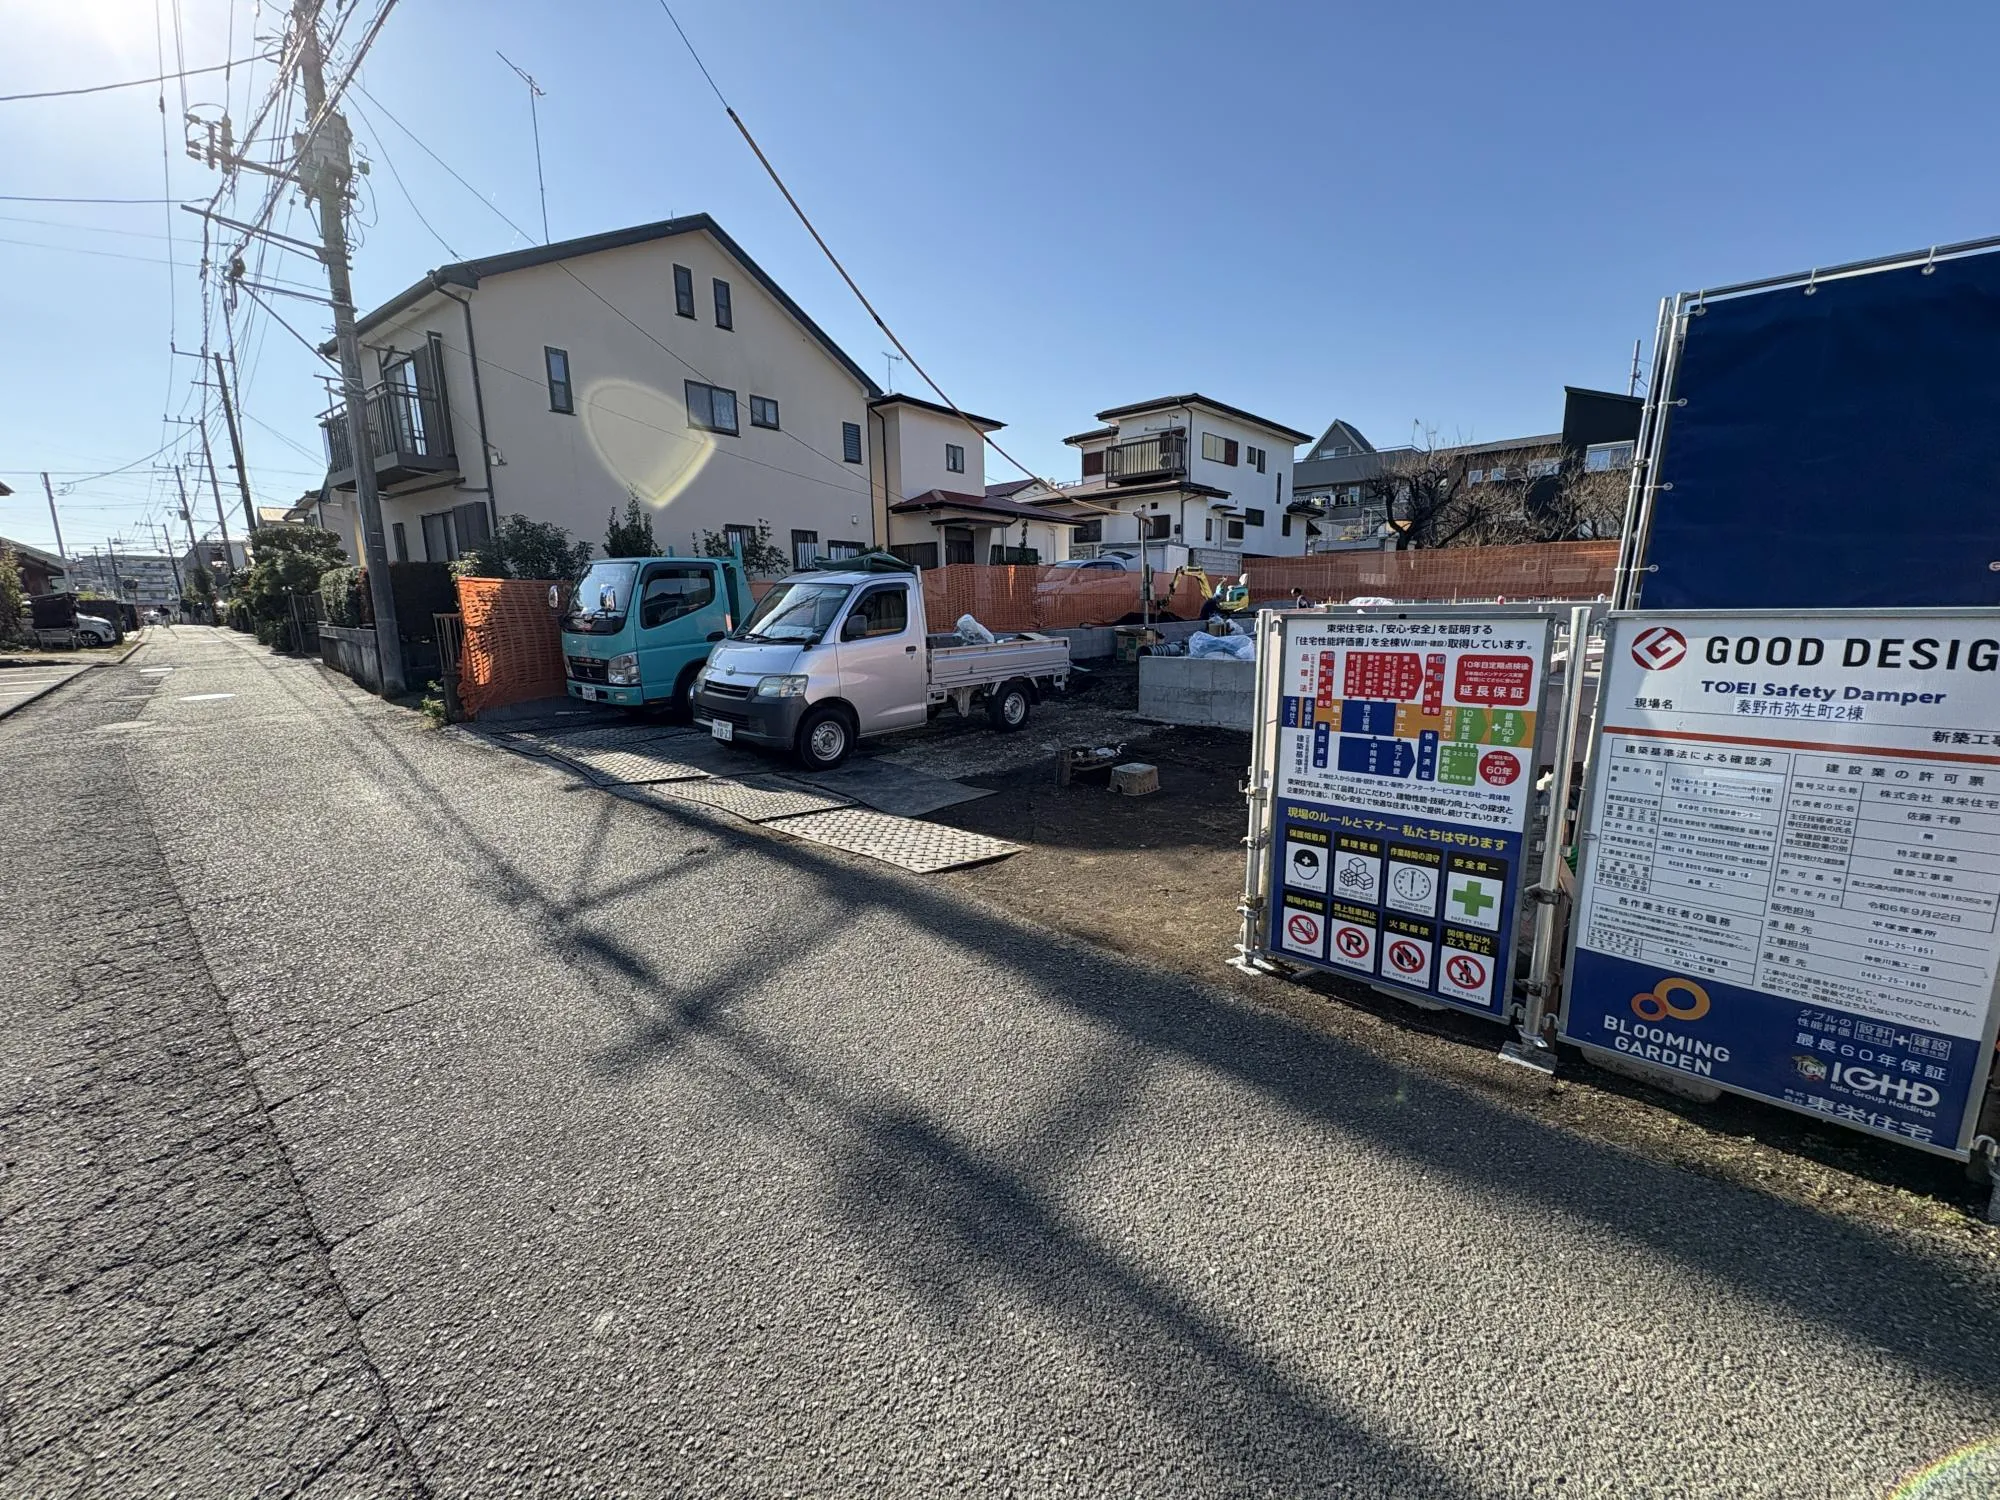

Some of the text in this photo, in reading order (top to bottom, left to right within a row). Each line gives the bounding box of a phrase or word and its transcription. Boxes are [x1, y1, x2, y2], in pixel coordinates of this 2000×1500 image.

[1705, 635, 1825, 667] GOOD
[1459, 684, 1525, 699] 延長保証
[1763, 682, 1837, 701] Safety
[1844, 686, 1947, 707] Damper
[1634, 697, 1674, 711] 現場名
[1736, 699, 1865, 721] 秦野市弥生町2棟
[1625, 745, 1773, 767] 建築基準法による確認済
[1486, 766, 1513, 776] 60年
[1825, 763, 1985, 787] 建設業の許可票
[1880, 790, 2000, 809] 株式会社 東栄住宅
[1288, 806, 1508, 851] 現場のルールとマナー 私たちは守ります
[1454, 858, 1499, 872] 安全第一
[1618, 897, 1731, 927] 各作業主任者の職務
[1770, 902, 1815, 918] 販売担当
[1868, 902, 1961, 922] 令和6年9月22日
[1767, 919, 1813, 935] 連絡先
[1446, 938, 1490, 954] 立入禁止
[1762, 952, 1807, 968] 連絡先
[1797, 1018, 1851, 1037] 性能評価
[1800, 1009, 1852, 1028] ダブルの
[1603, 1015, 1730, 1062] BLOOMING
[1858, 1023, 1949, 1053] 設計 建設
[1615, 1036, 1712, 1075] GARDEN
[1795, 1033, 1947, 1081] 最長60年保証
[1853, 1089, 1886, 1104] Group
[1889, 1100, 1937, 1118] Holdings
[1806, 1095, 1933, 1142] 東栄住宅
